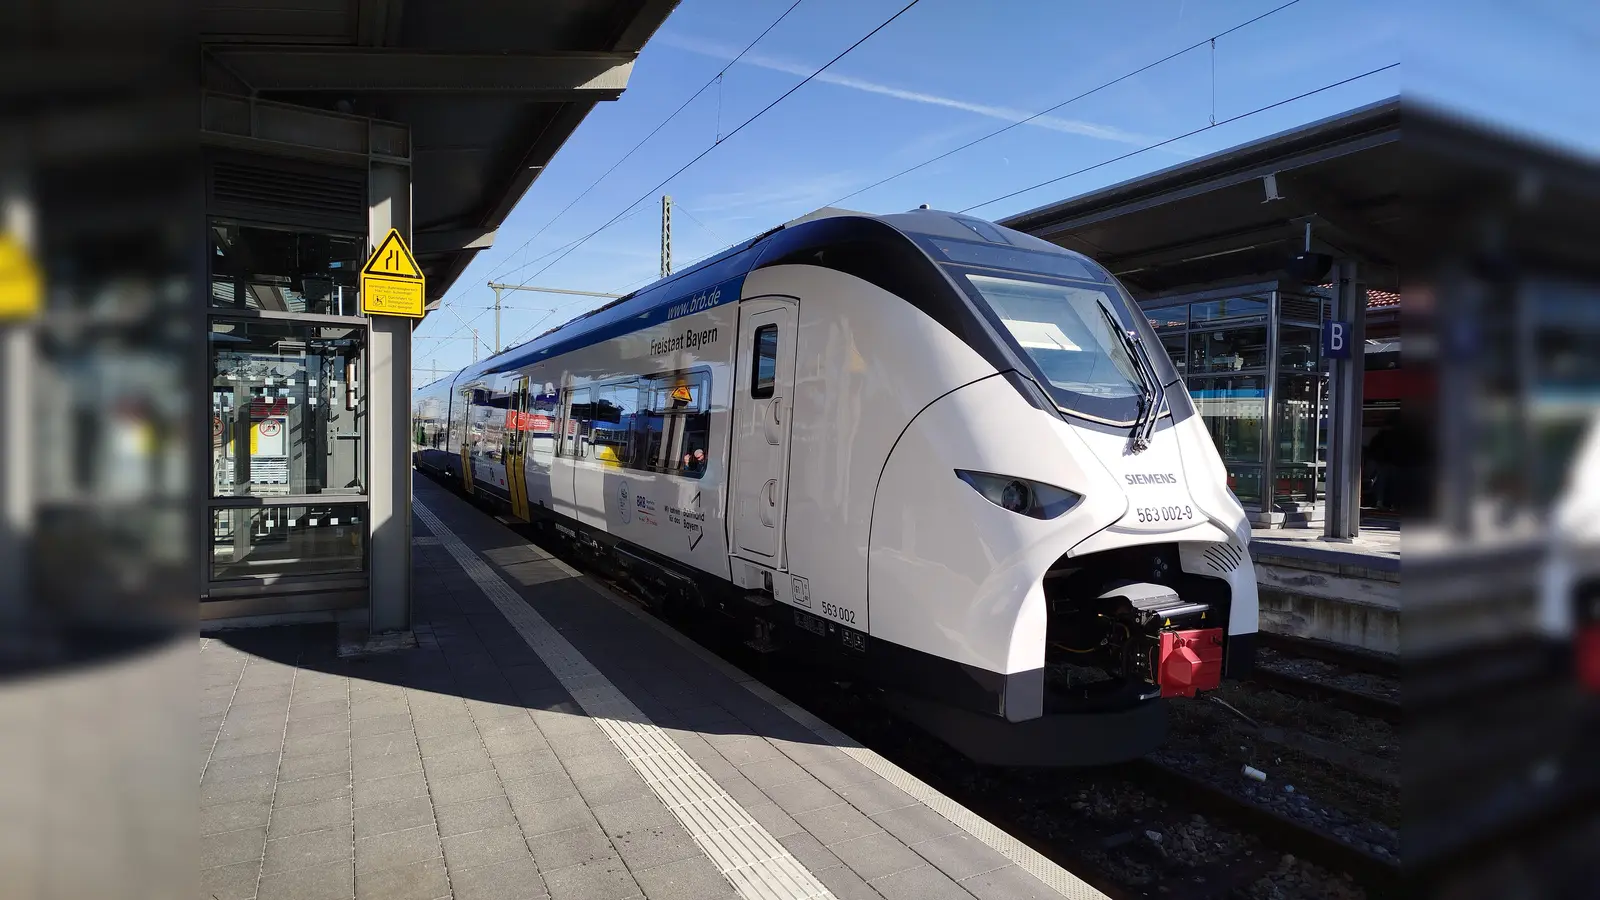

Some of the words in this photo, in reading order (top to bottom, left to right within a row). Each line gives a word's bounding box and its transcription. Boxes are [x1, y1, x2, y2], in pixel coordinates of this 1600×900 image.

[667, 285, 721, 320] www.brb.de
[650, 334, 684, 356] Freistaat
[686, 327, 718, 350] Bayern
[1331, 323, 1343, 351] B
[1124, 473, 1177, 485] SIEMENS
[683, 518, 700, 532] Bayern
[1136, 506, 1161, 523] 563
[1161, 505, 1193, 521] 002-9
[821, 600, 838, 618] 563
[838, 606, 856, 625] 002
